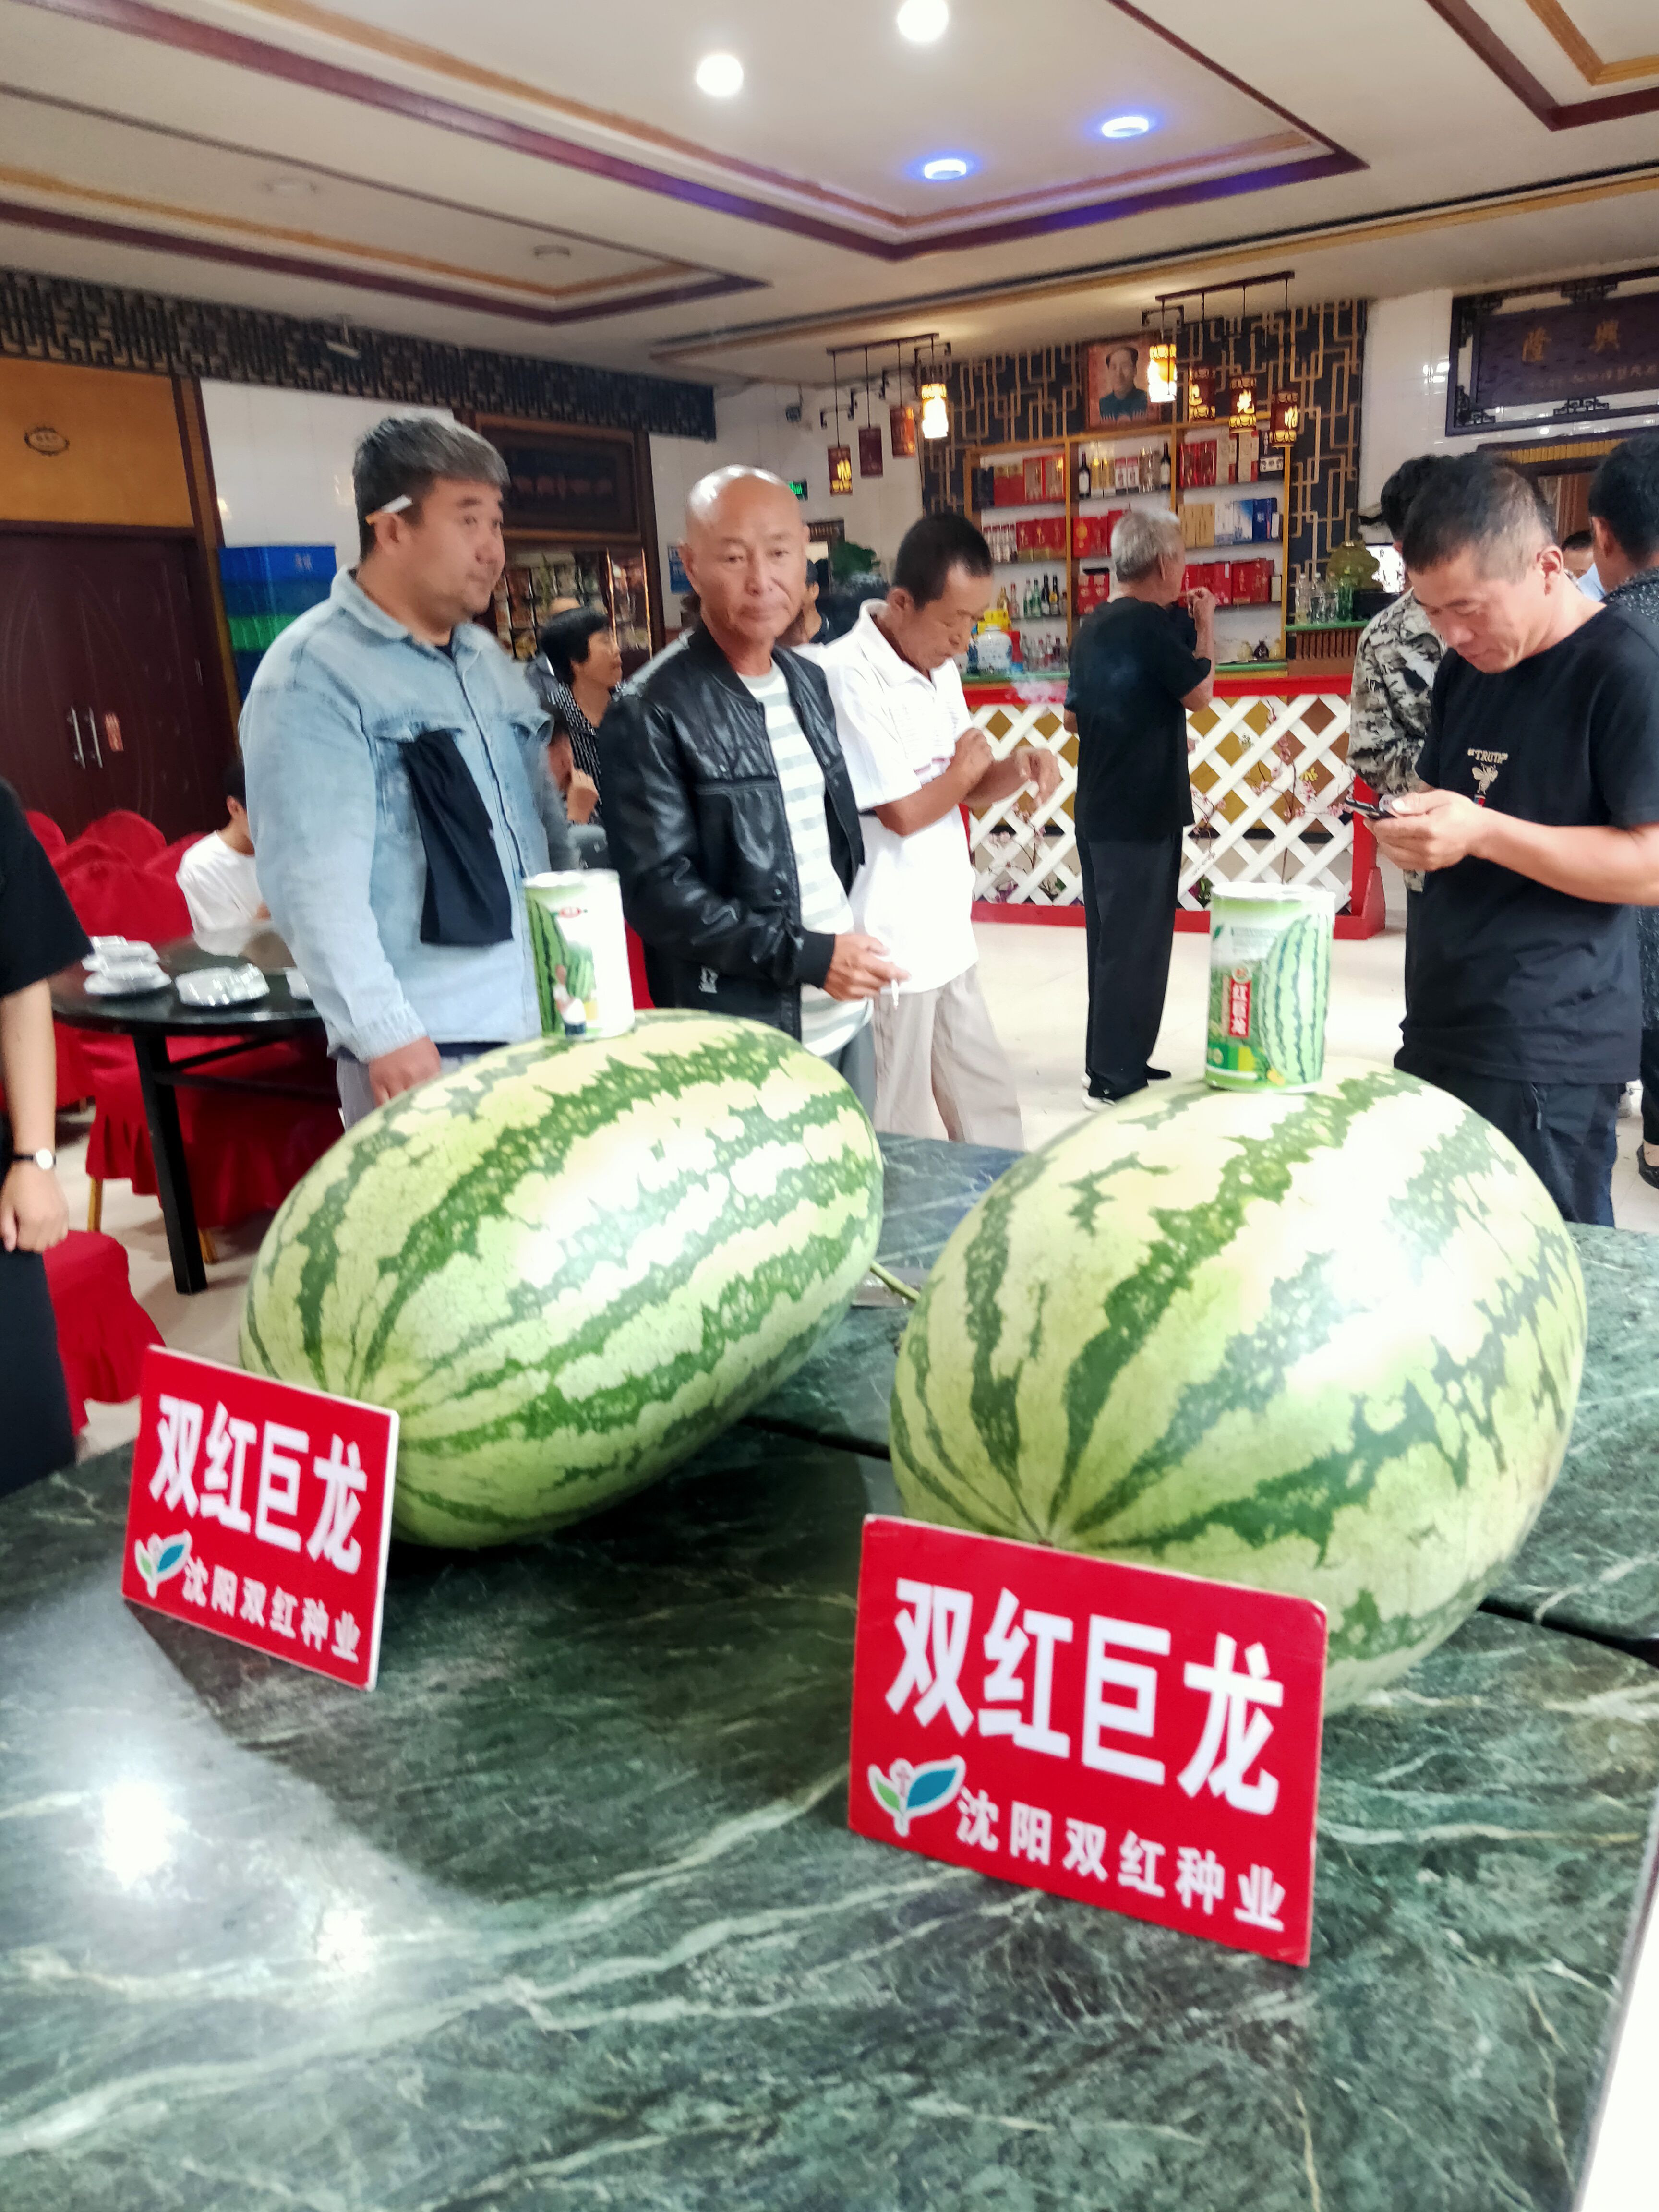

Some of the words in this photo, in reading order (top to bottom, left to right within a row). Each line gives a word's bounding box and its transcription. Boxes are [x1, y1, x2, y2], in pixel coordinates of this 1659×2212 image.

[148, 1394, 367, 1574] 双红巨龙
[182, 1556, 361, 1663] 沈阳双红种业
[885, 1577, 1283, 1815] 双红巨龙
[956, 1785, 1286, 1932] 沈阳双红种业
